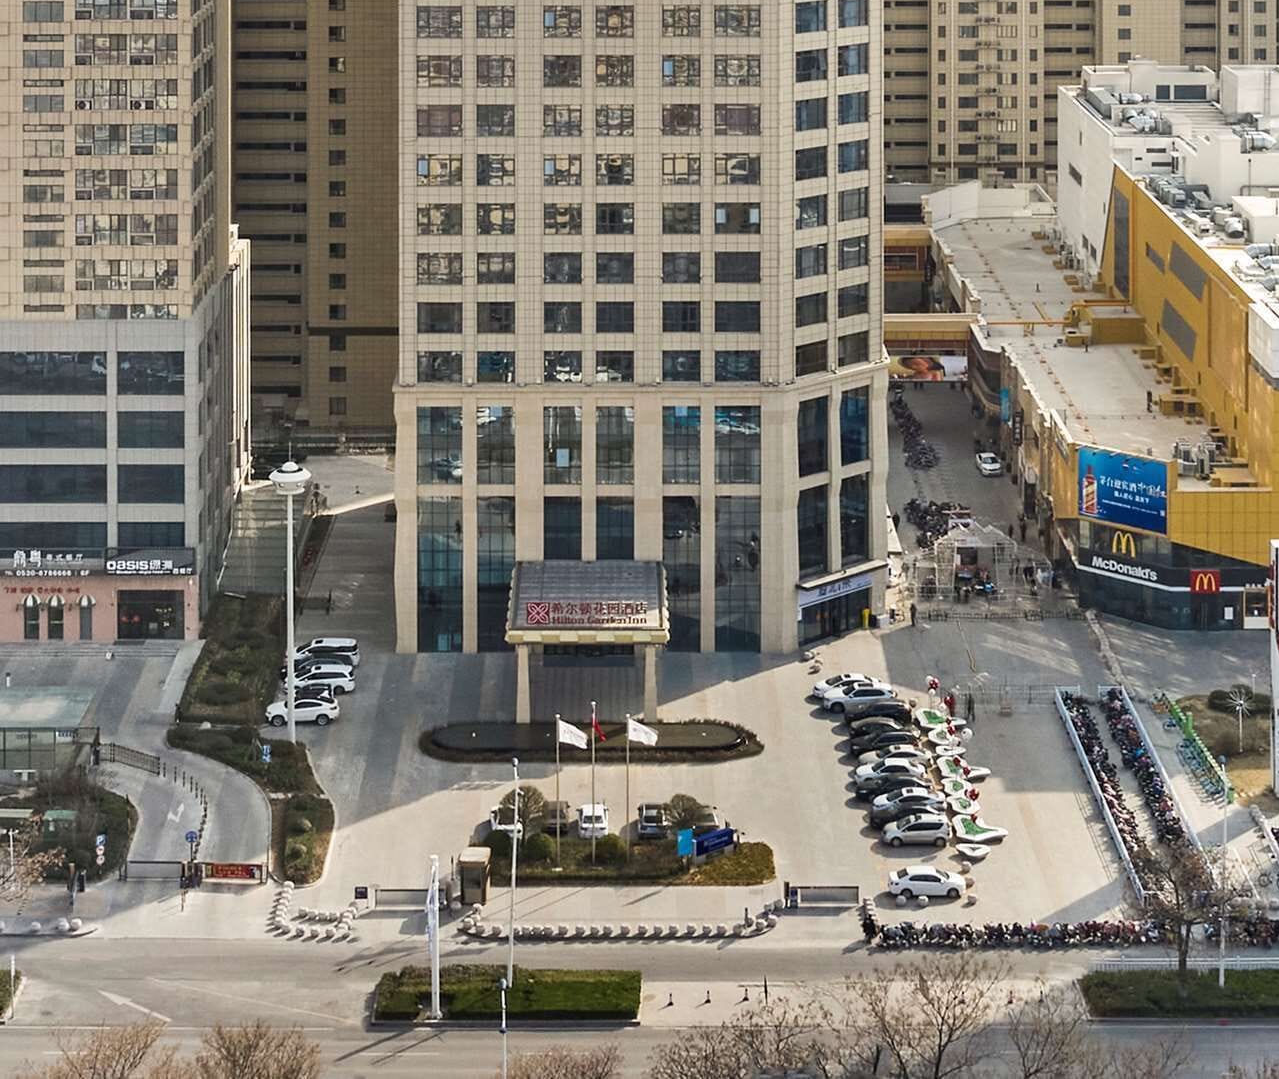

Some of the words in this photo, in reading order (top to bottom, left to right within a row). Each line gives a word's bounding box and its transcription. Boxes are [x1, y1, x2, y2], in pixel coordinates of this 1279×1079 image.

[1091, 555, 1158, 582] McDonald's
[551, 601, 648, 615] 希尔顿花园酒店
[552, 616, 585, 624] Hilton
[587, 616, 626, 624] Garden
[628, 616, 647, 624] Inn
